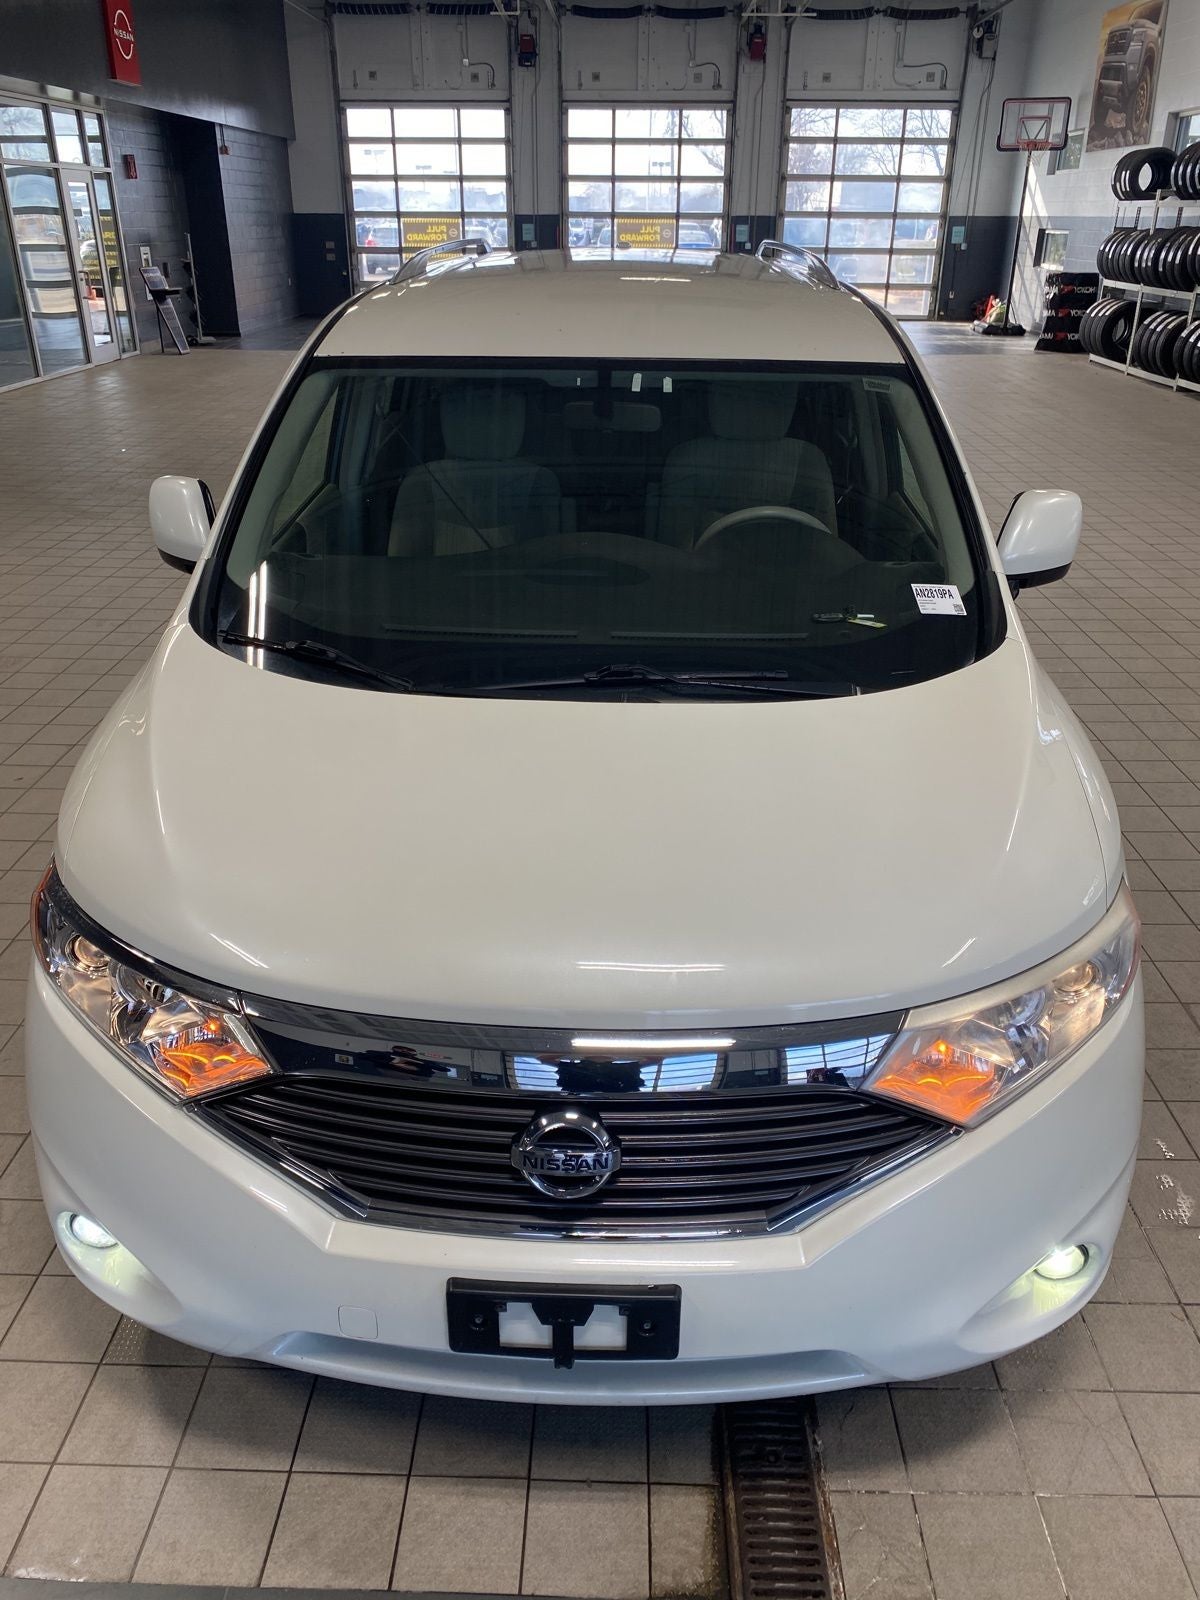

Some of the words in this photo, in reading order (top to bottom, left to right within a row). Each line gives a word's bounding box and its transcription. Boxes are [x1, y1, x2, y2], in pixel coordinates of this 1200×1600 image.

[113, 27, 134, 41] NISSAN
[915, 587, 954, 600] AN2819PA
[522, 1153, 609, 1172] NISSAN
